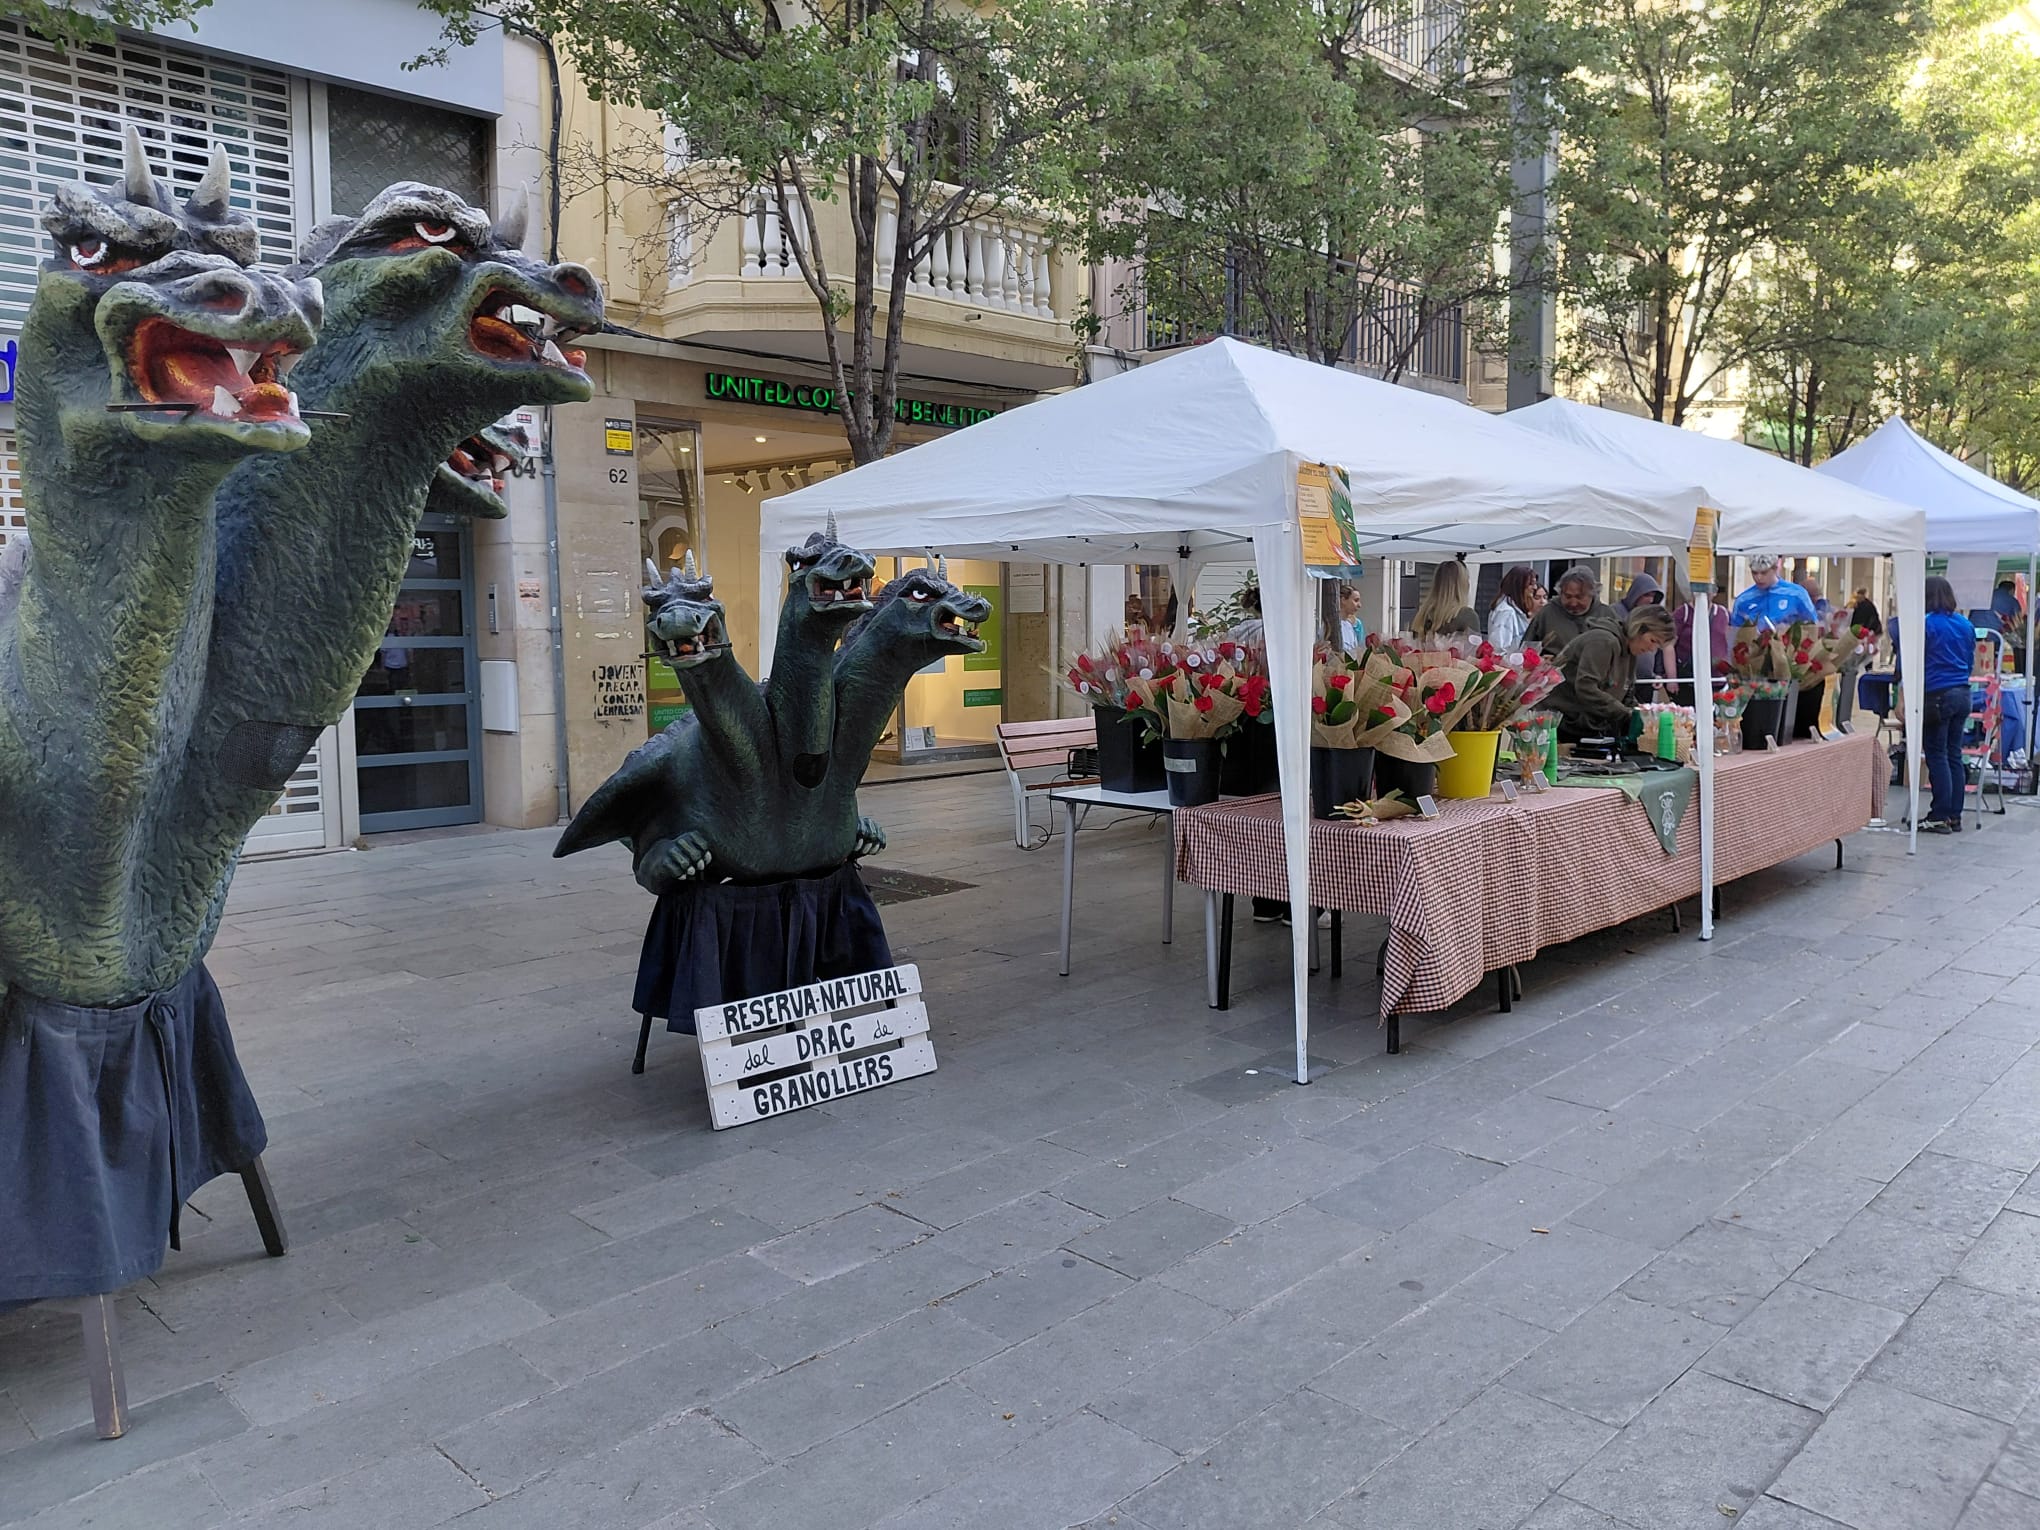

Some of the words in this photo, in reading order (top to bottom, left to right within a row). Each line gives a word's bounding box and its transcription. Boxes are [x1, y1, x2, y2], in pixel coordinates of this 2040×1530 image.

[707, 372, 792, 404] UNITED
[911, 400, 1000, 426] BENETTO
[609, 468, 628, 484] 62
[598, 664, 644, 680] JOVENT
[602, 693, 645, 704] CONTRA
[722, 988, 818, 1035] RESERVA
[819, 969, 908, 1012] NATURAL
[743, 1044, 775, 1074] del
[796, 1022, 856, 1062] DRAC
[873, 1019, 894, 1040] de
[753, 1054, 894, 1117] GRANOLLERS
